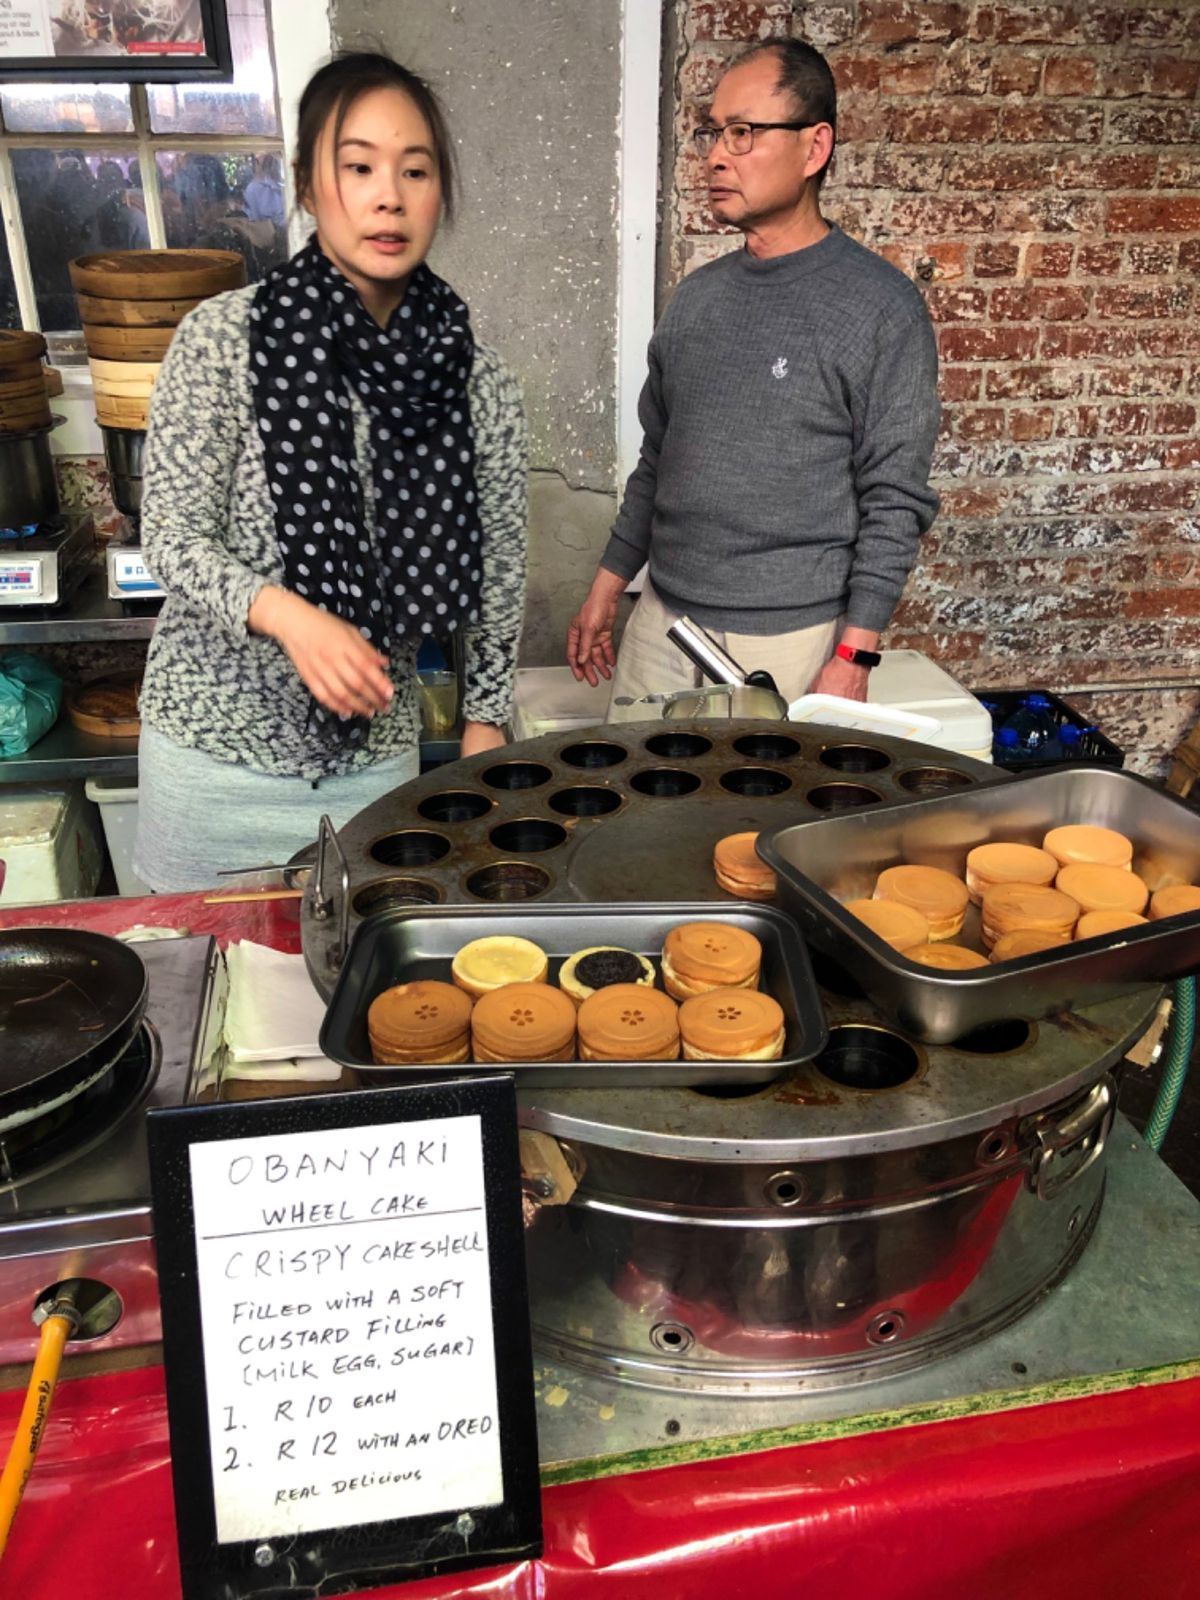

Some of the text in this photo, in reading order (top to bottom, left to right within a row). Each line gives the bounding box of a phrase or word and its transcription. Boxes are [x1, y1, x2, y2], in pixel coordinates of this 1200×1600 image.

[263, 1194, 427, 1226] WHEEL CAKE
[388, 1289, 400, 1304] A
[411, 1280, 463, 1302] SOFT
[239, 1328, 349, 1354] CUSTARD
[275, 1400, 293, 1421] R
[307, 1395, 332, 1417] 10
[353, 1389, 396, 1408] EACH
[223, 1447, 251, 1472] 2.
[278, 1439, 295, 1460] R
[313, 1431, 337, 1456] 12
[438, 1416, 492, 1440] OREO
[275, 1485, 318, 1505] REAL
